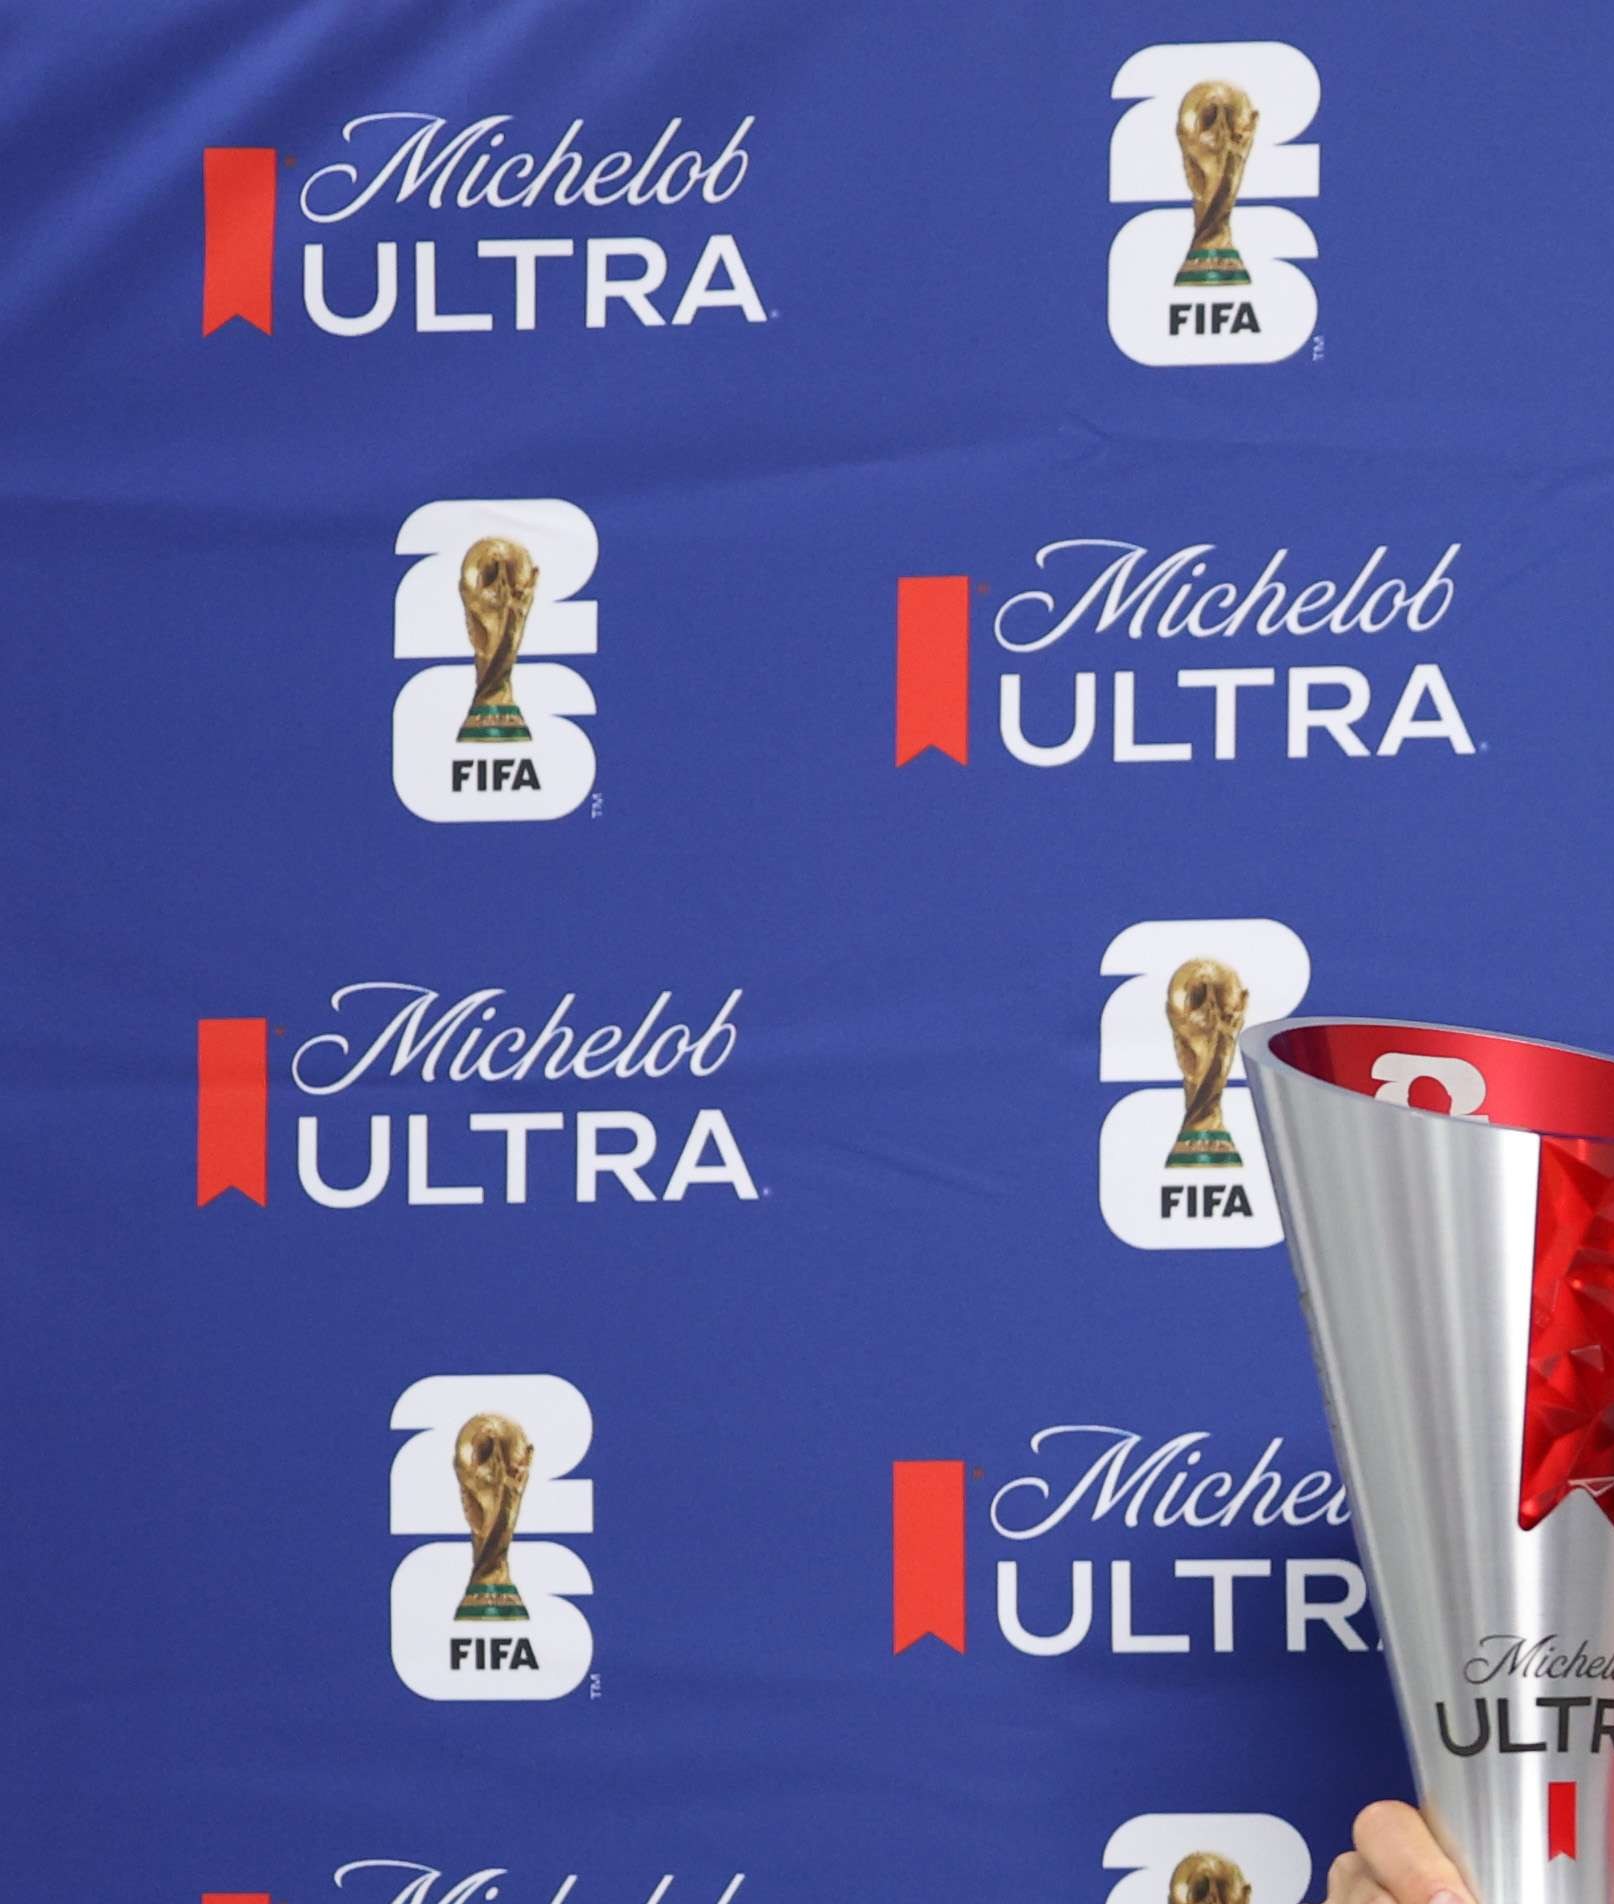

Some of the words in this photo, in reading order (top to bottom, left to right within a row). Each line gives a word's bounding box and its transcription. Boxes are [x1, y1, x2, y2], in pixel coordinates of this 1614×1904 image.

[299, 111, 757, 225] Michelob
[303, 234, 769, 337] ULTRA
[1170, 302, 1261, 336] FIFA
[994, 538, 1463, 654] Michelob
[999, 663, 1477, 768] ULTRA
[452, 758, 542, 793] FIFA
[291, 981, 744, 1097] Michelob
[297, 1108, 761, 1209] ULTRA
[1161, 1184, 1254, 1219] FIFA
[990, 1414, 1348, 1542] Miche
[450, 1637, 540, 1671] FIFA
[996, 1558, 1369, 1657] ULTR
